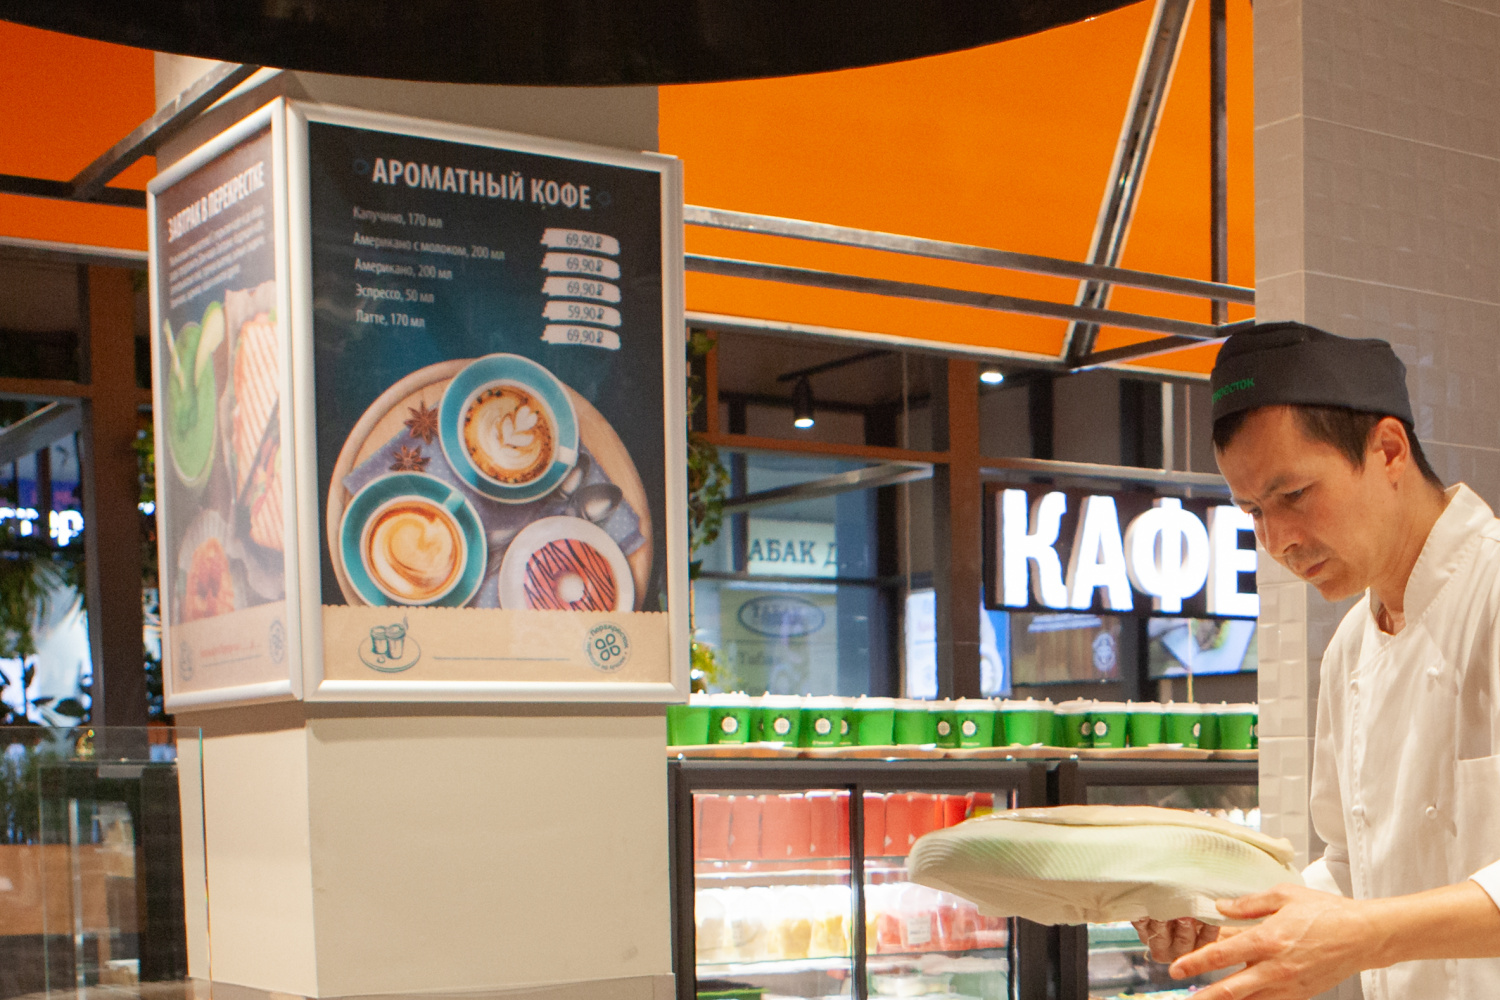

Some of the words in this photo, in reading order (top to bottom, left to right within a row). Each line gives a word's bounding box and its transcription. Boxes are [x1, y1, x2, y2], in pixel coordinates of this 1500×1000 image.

[372, 157, 524, 201] АРОМАТНЫЙ
[530, 178, 591, 210] КОФЕ
[356, 284, 403, 302] Эспрессо,
[406, 289, 418, 302] 50
[420, 294, 434, 303] мл
[356, 309, 388, 326] Латте,
[391, 313, 408, 326] 170
[410, 318, 425, 328] мл
[996, 488, 1260, 617] КАФЕ
